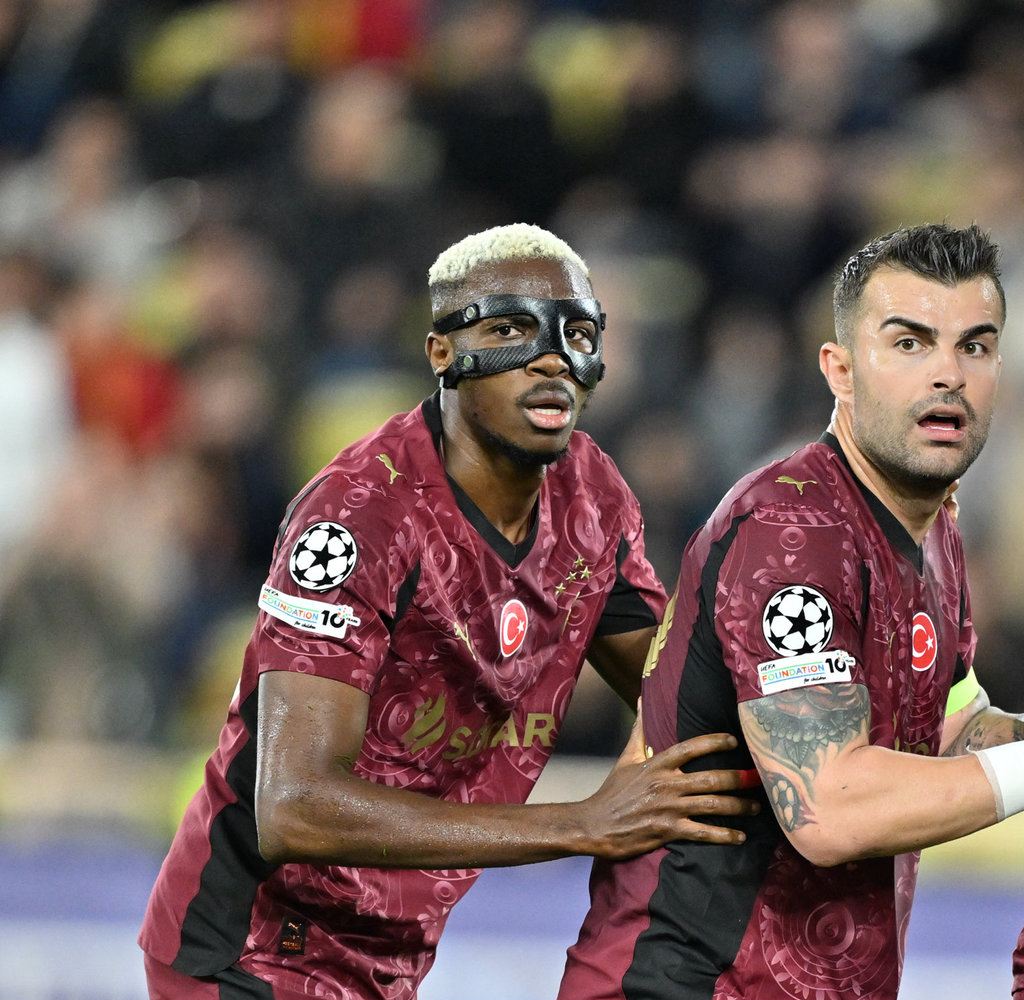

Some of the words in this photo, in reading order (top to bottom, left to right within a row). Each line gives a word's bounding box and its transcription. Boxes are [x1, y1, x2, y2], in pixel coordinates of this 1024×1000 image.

[264, 587, 279, 597] UEFA
[262, 594, 320, 620] FOUNDATION
[321, 609, 345, 628] 10
[760, 663, 775, 672] UEFA
[762, 664, 825, 682] FOUNDATION
[825, 658, 847, 673] 10
